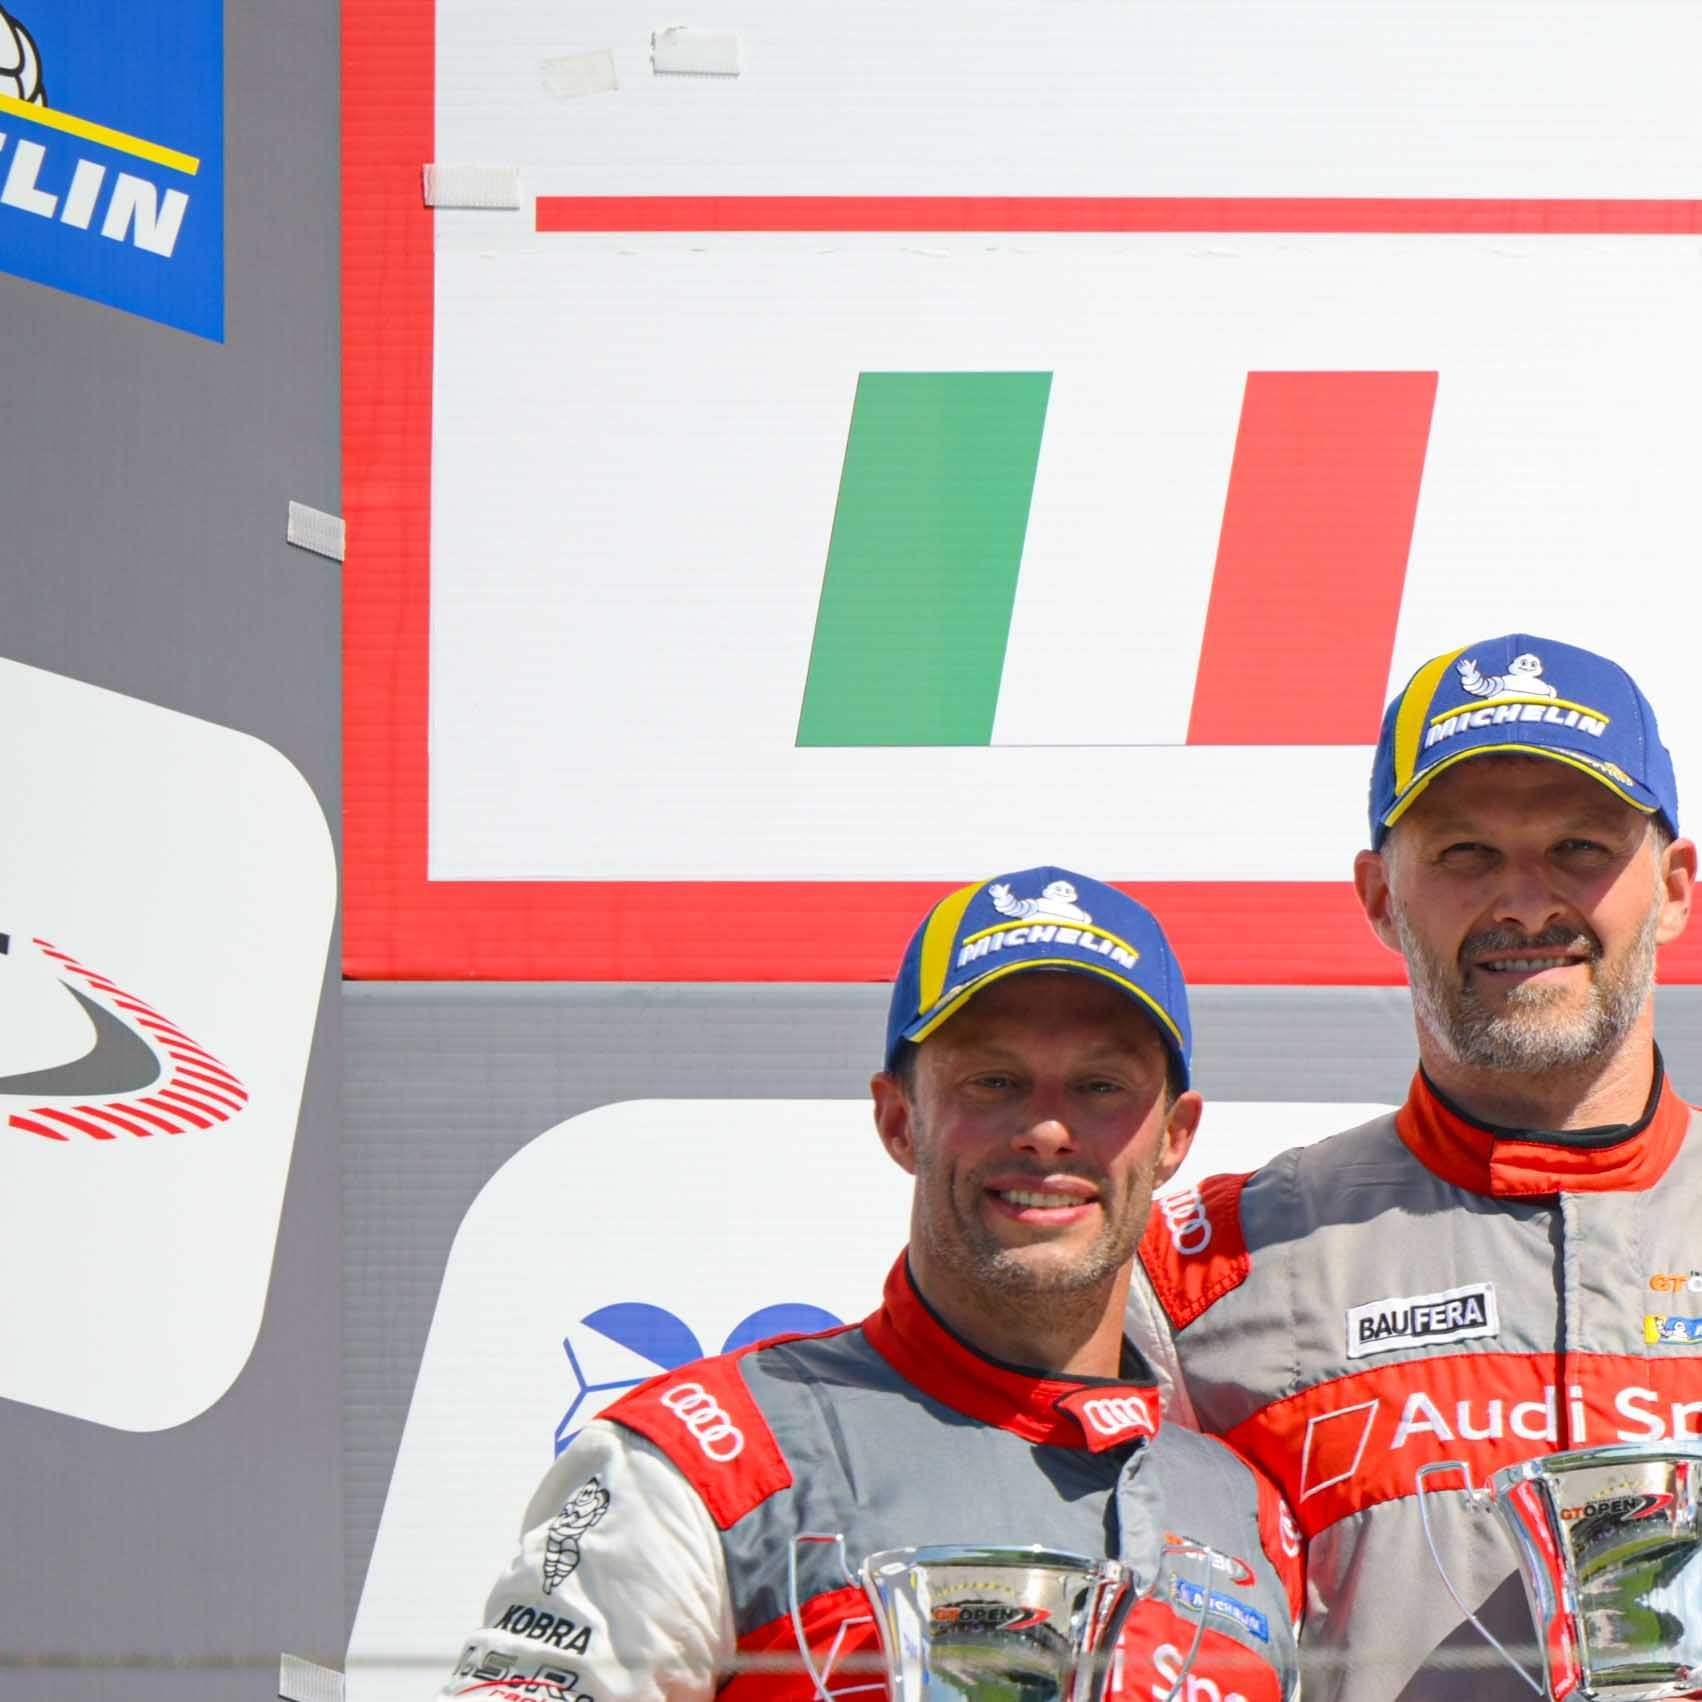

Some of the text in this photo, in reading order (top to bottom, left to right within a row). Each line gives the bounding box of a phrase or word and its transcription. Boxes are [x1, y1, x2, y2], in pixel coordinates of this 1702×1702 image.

[0, 132, 189, 258] LIN
[1424, 700, 1606, 747] MICHELIN
[957, 924, 1138, 970] MICHELIN
[1391, 1386, 1586, 1451] Audi
[493, 1604, 593, 1656] KOBRA
